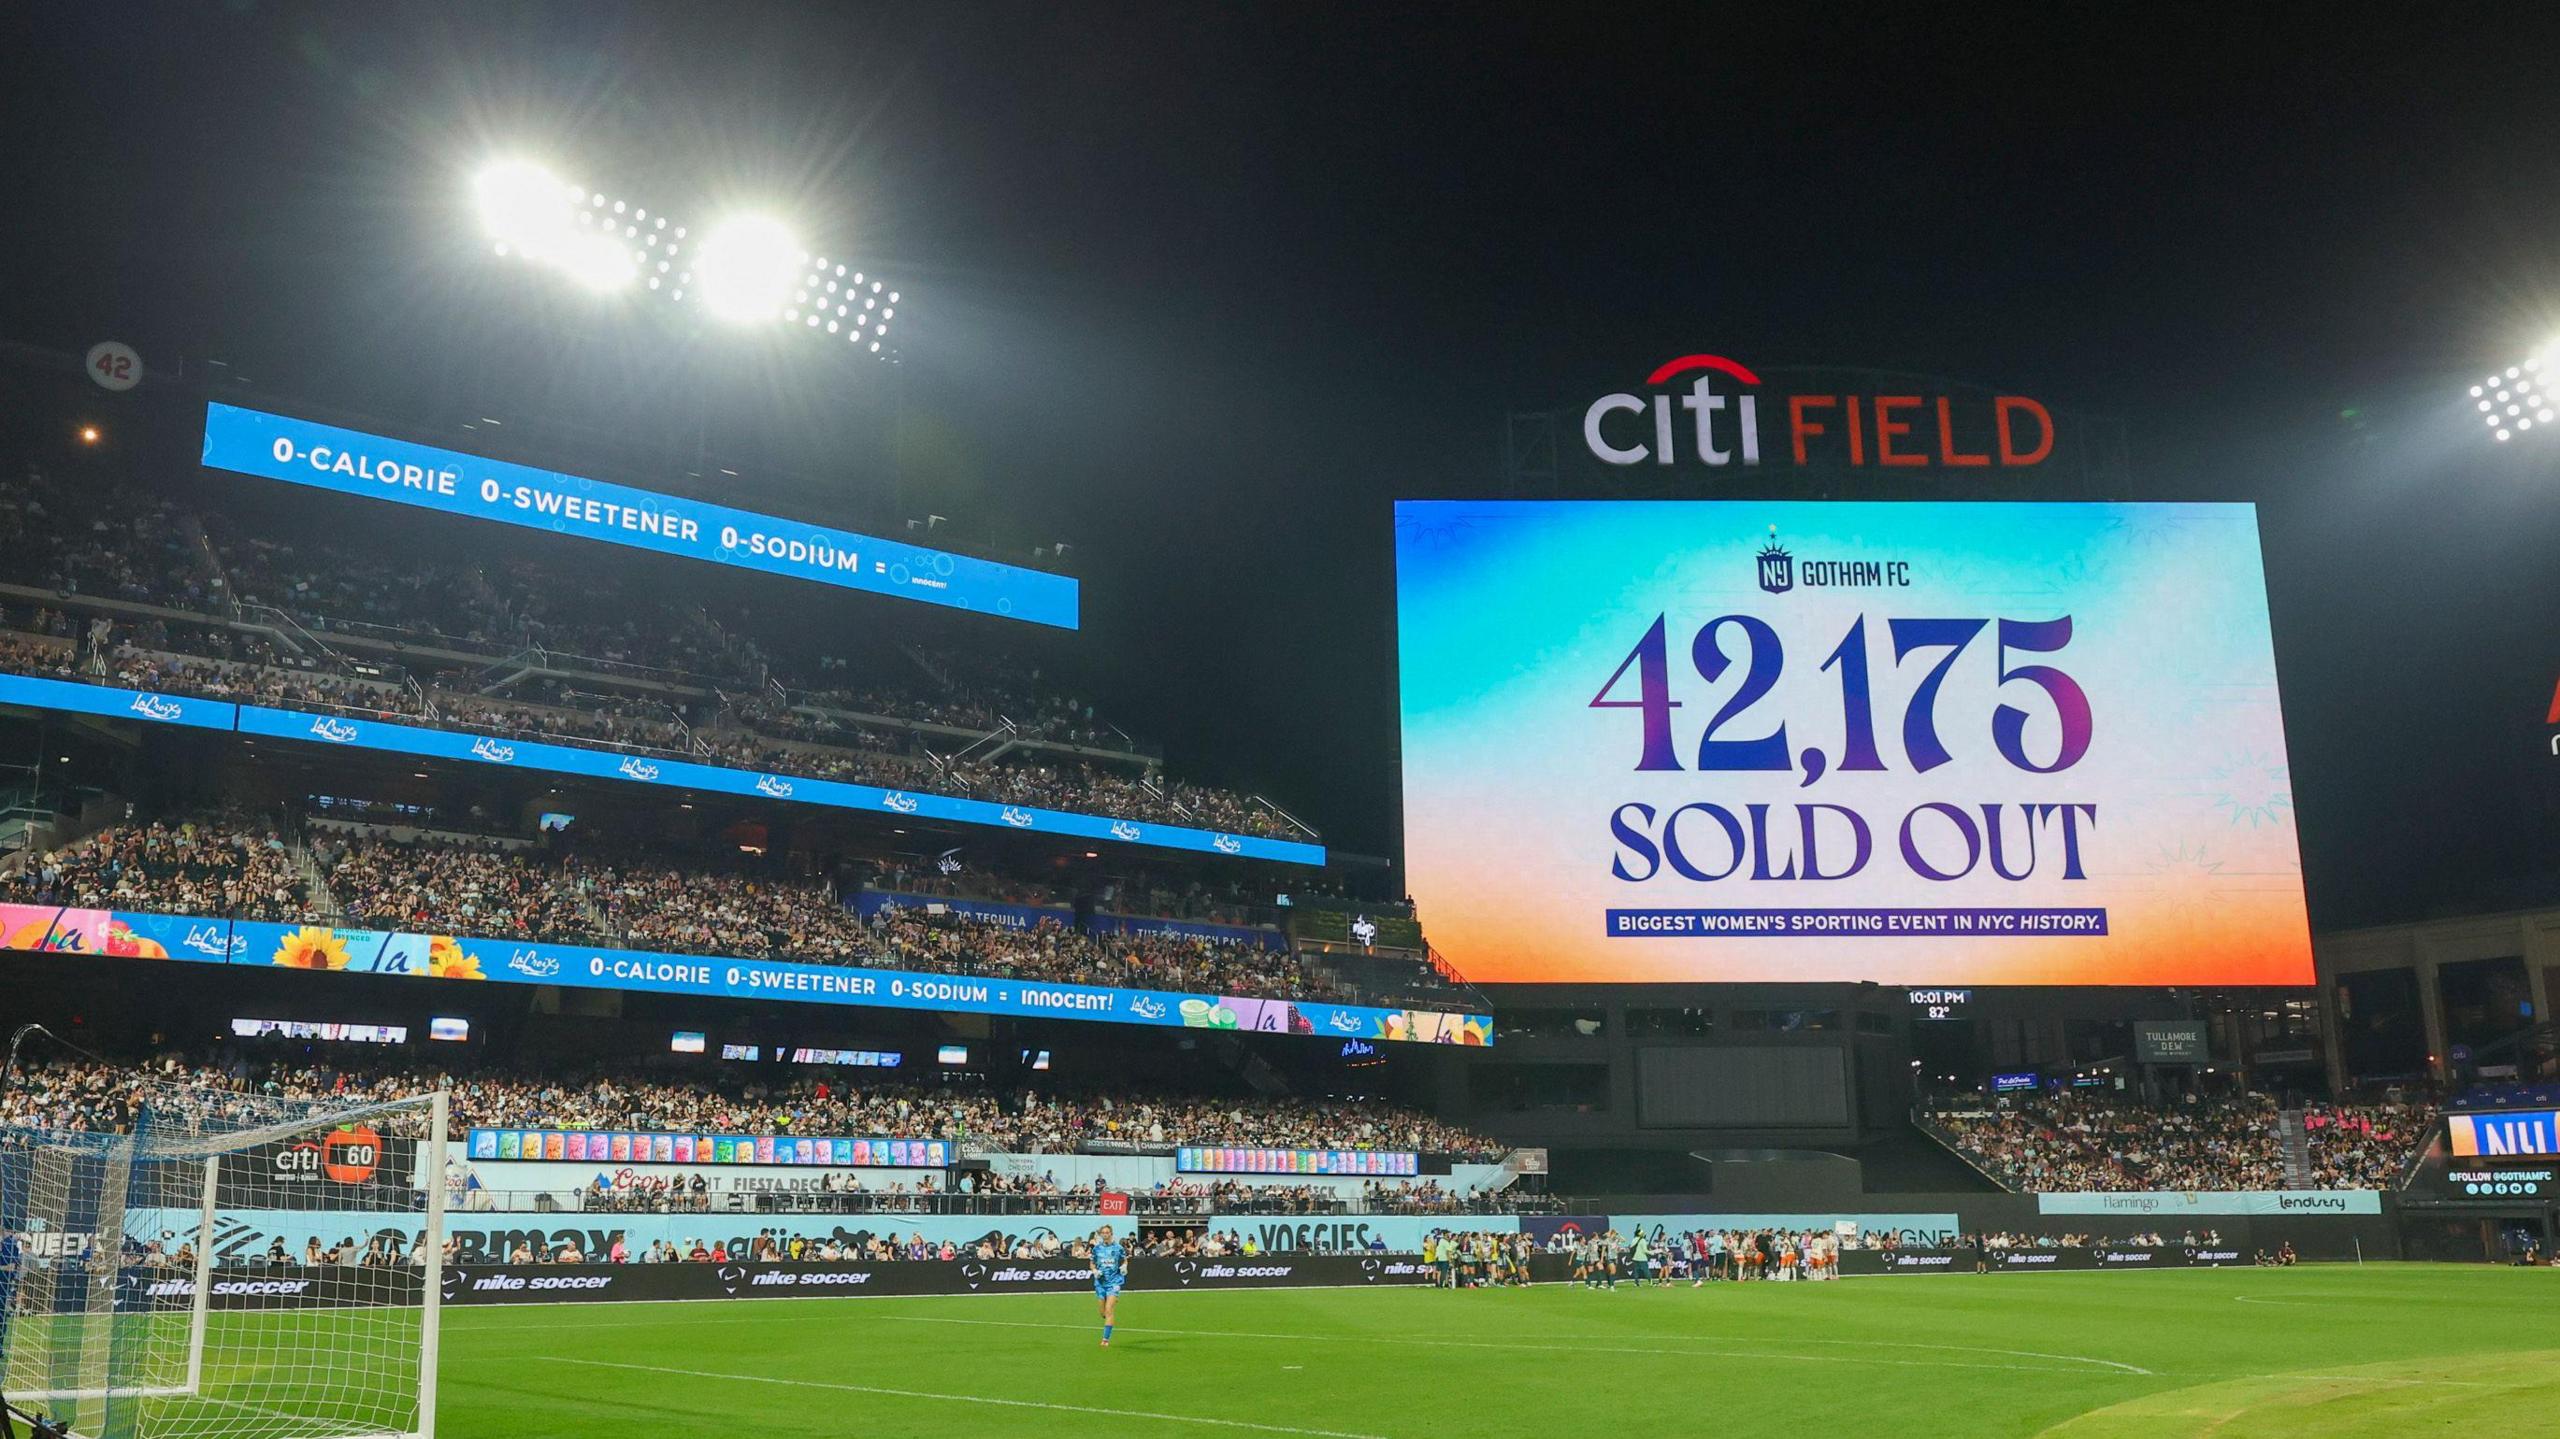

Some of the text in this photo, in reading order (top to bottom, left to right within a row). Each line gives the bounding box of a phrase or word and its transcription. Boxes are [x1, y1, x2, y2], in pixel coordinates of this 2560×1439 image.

[96, 353, 131, 380] 42
[1584, 366, 2055, 467] citi FIELD
[272, 436, 457, 496] 0-CALORIE
[480, 479, 699, 541] 0-SWEETENER
[721, 526, 859, 573] 0-SODIUM
[1802, 561, 1910, 587] GOTHAM FC
[1588, 610, 2093, 788] 42,175
[1609, 801, 2098, 883] SOLD OUT
[975, 911, 1026, 928] TEQUILA
[1618, 914, 2101, 931] BIGGEST WOMEN'S SPORTING EVENT IN NYC HISTORY.
[589, 957, 711, 985] 0-CALORIE
[727, 969, 877, 995] 0-SWEETENER
[891, 979, 988, 1003] 0-SODIUM
[1909, 991, 1965, 1004] 10:01 PM
[1929, 1006, 1950, 1018] 82°
[2146, 1032, 2197, 1041] TULLAMORE
[2161, 1041, 2182, 1050] DEW
[276, 1146, 318, 1170] citi
[347, 1145, 373, 1165] 60
[734, 1178, 783, 1192] FIESTA
[1103, 1199, 1123, 1211] EXIT
[2103, 1196, 2159, 1212] flamingo
[2279, 1194, 2345, 1212] lendistry
[1897, 1255, 1952, 1265] nike soccer
[2008, 1253, 2057, 1263] nike soccer
[2107, 1251, 2152, 1262] nike soccer
[2197, 1250, 2239, 1260] nike soccer
[991, 1266, 1095, 1282] nike soccer
[1200, 1264, 1292, 1278] nike soccer
[1384, 1261, 1415, 1275] nike
[472, 1274, 613, 1291] nike soccer
[751, 1270, 872, 1286] nike soccer
[211, 1280, 310, 1296] soccer
